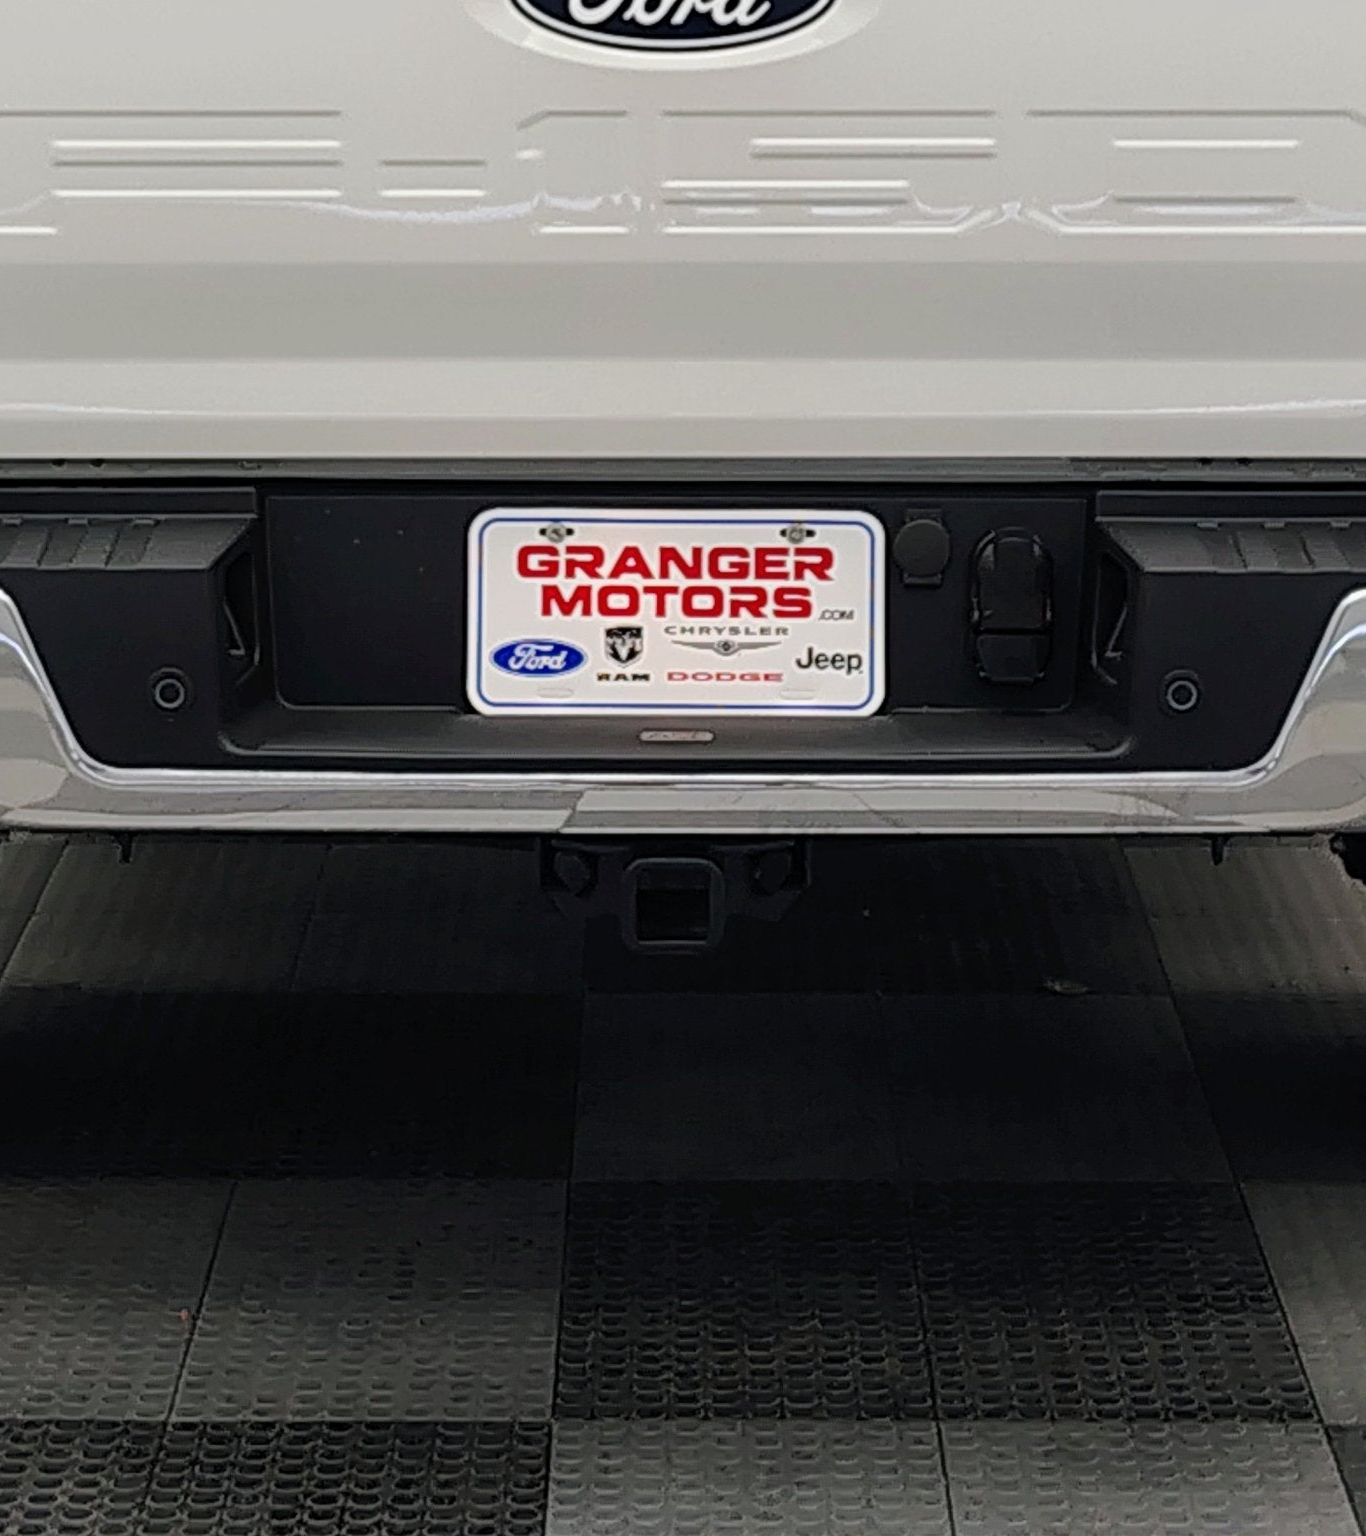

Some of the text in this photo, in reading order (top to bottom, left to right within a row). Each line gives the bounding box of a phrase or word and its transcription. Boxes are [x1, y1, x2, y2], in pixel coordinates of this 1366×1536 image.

[517, 545, 834, 581] GRANGER
[541, 585, 813, 619] MOTORS
[664, 625, 789, 636] CHRYSLER
[508, 642, 569, 670] Ford
[795, 647, 864, 675] Jeep
[596, 672, 651, 682] RAM
[667, 671, 784, 682] DODGE
